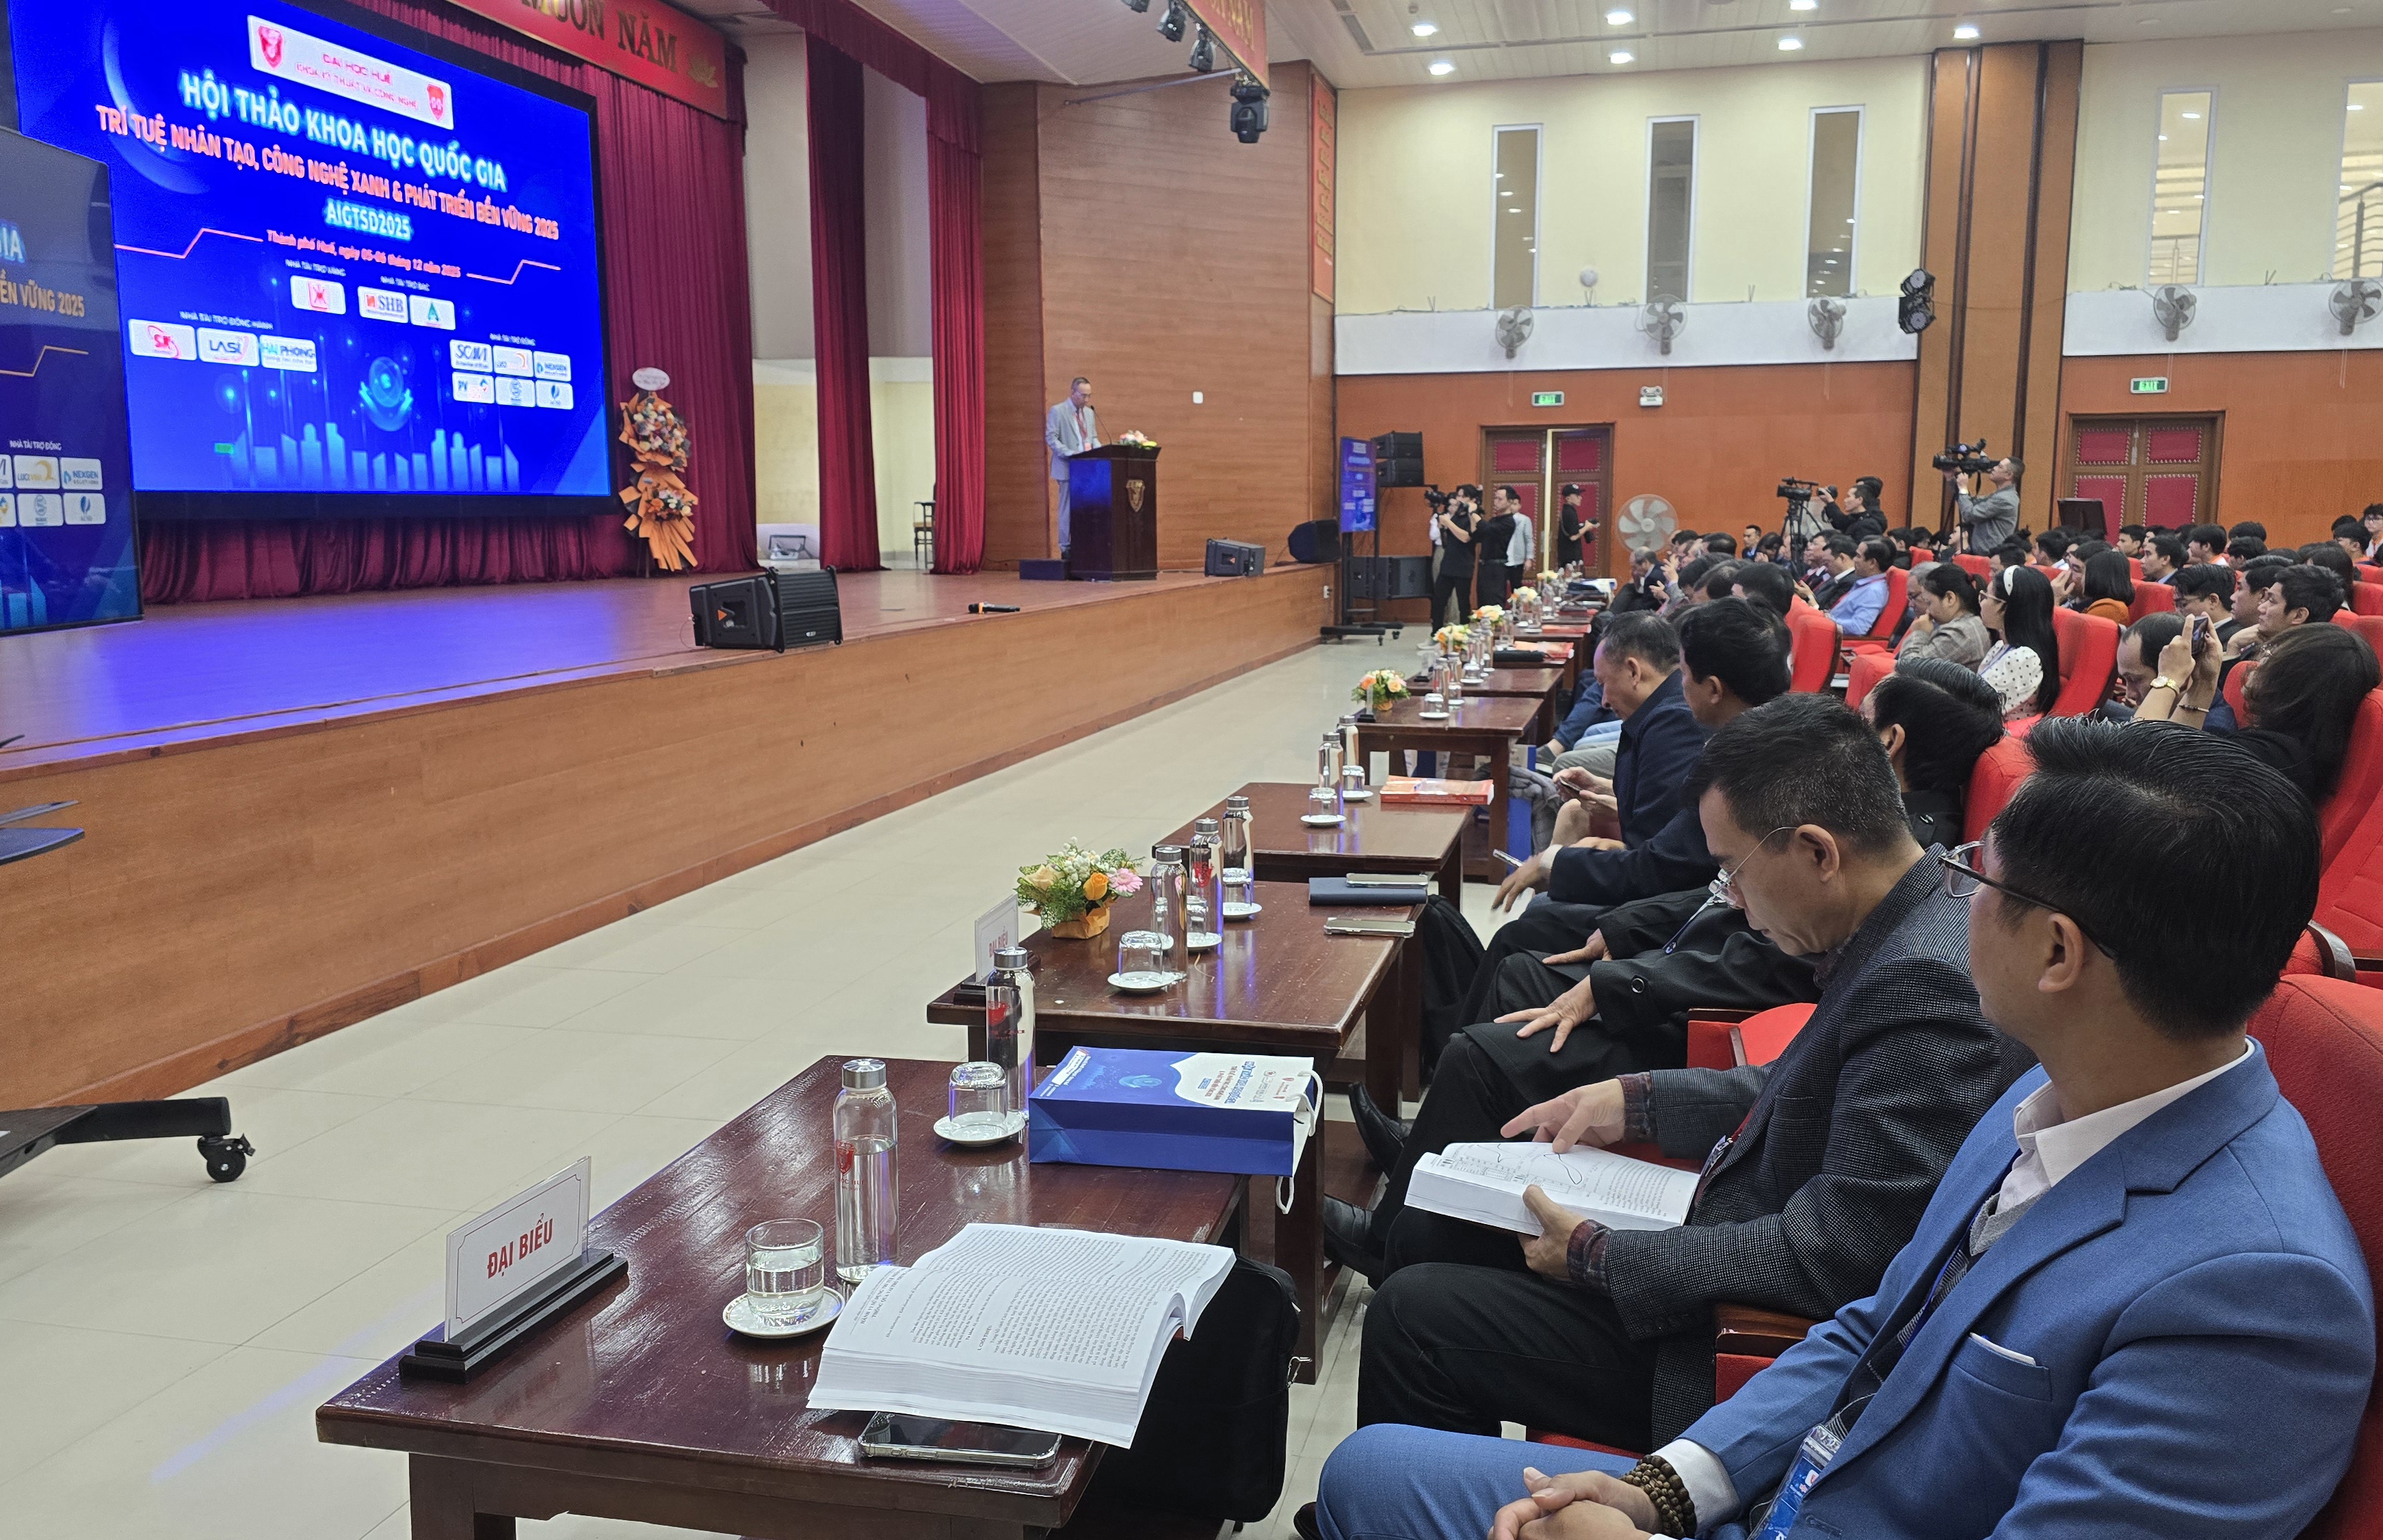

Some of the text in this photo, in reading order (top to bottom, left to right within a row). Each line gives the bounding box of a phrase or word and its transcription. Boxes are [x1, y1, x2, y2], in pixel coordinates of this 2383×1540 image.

[618, 10, 678, 72] NĂM
[180, 66, 508, 193] HỘI THẢO KHOA HỌC QUỐC GIA
[96, 104, 128, 135] TRÍ
[131, 114, 167, 152] TUỆ
[170, 124, 221, 158] NHÂN
[222, 137, 260, 170] TẠO,
[262, 144, 305, 178] CÔNG
[308, 161, 348, 195] NGHỆ
[351, 170, 390, 200] XANH
[393, 181, 403, 202] &
[404, 183, 438, 211] PHÁT
[438, 188, 475, 220] TRIỂN
[534, 216, 559, 240] 2025
[324, 199, 412, 241] AIGTSD2025
[0, 226, 25, 263] IA
[19, 279, 55, 312] VỮNG
[57, 291, 85, 317] 2025
[378, 295, 404, 313] SHB
[2140, 380, 2159, 390] EXIT
[73, 470, 98, 479] NEXGEN
[487, 1212, 553, 1279] ĐẠI BIỂU
[860, 1312, 870, 1323] HÀNH
